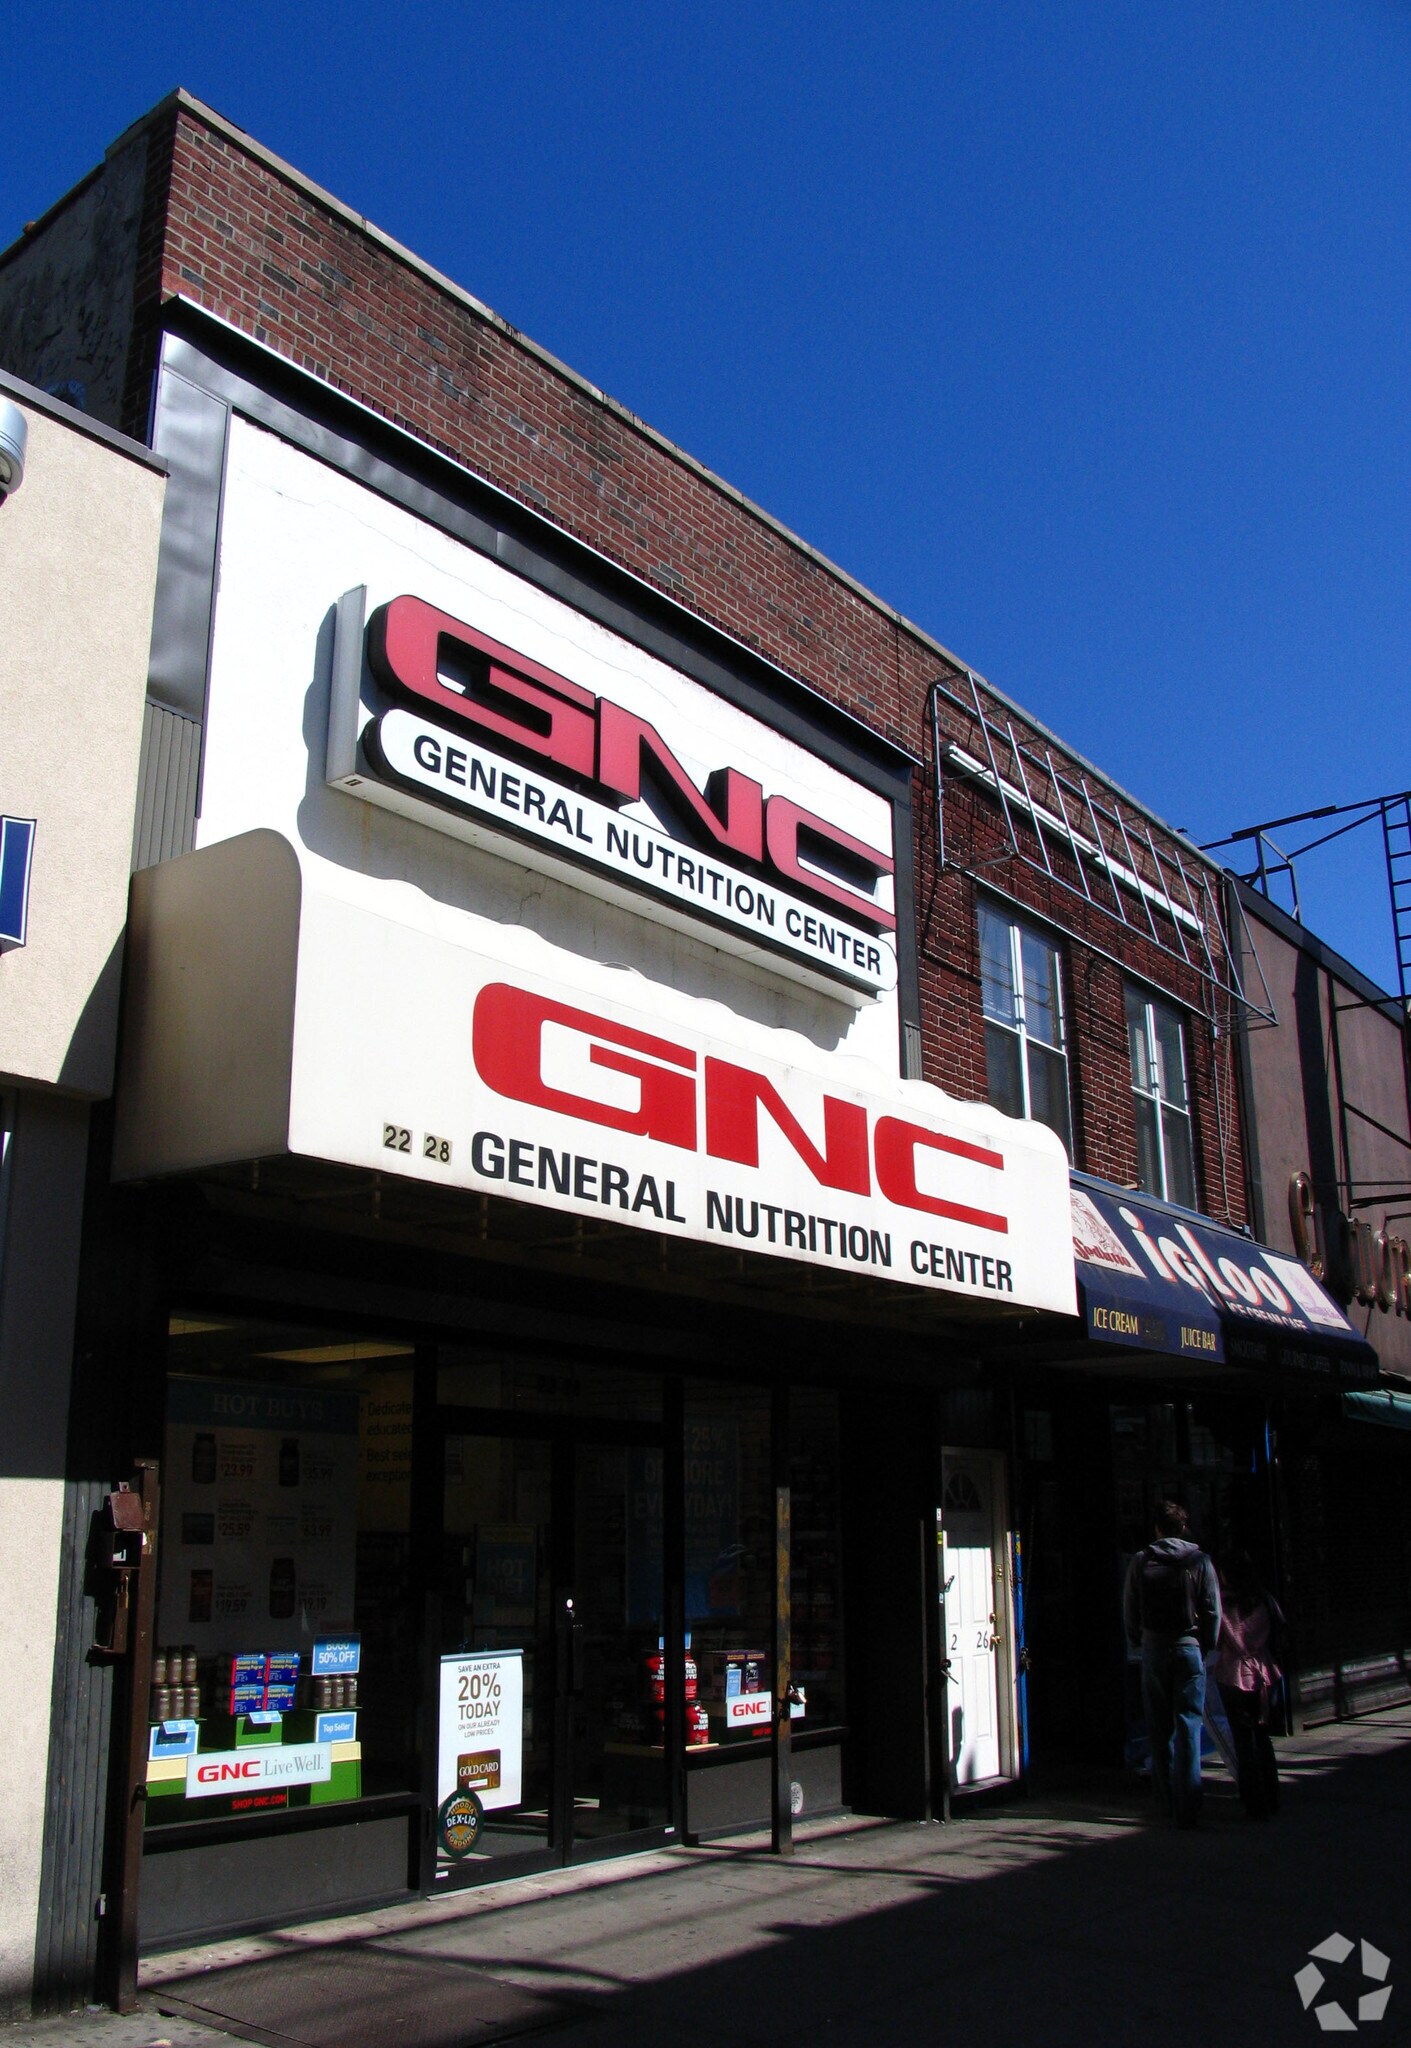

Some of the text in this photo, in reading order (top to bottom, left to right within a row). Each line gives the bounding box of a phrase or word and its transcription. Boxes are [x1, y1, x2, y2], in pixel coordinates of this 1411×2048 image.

[381, 594, 896, 933] GNC
[413, 735, 881, 976] GENERAL NUTRITION CENTER
[473, 982, 1009, 1234] GNC
[384, 1126, 451, 1163] 22 28
[471, 1131, 1013, 1293] GENERAL NUTRITION CENTER
[1093, 1307, 1138, 1335] ICE CREAM
[1181, 1326, 1201, 1349] JUICE
[1202, 1331, 1216, 1351] BAR
[213, 1393, 323, 1420] HOT BUYS
[951, 1631, 989, 1651] 2 26
[319, 1650, 356, 1664] 50% OFF
[458, 1665, 473, 1673] SAVE
[482, 1662, 501, 1670] EXTRA
[458, 1673, 501, 1701] 20%
[458, 1701, 501, 1720] TODAY
[733, 1701, 767, 1717] GNC
[323, 1722, 351, 1733] Top Seller
[464, 1728, 494, 1738] LOW PRICES
[197, 1761, 261, 1783] GNC
[459, 1761, 499, 1777] GOLD CARD
